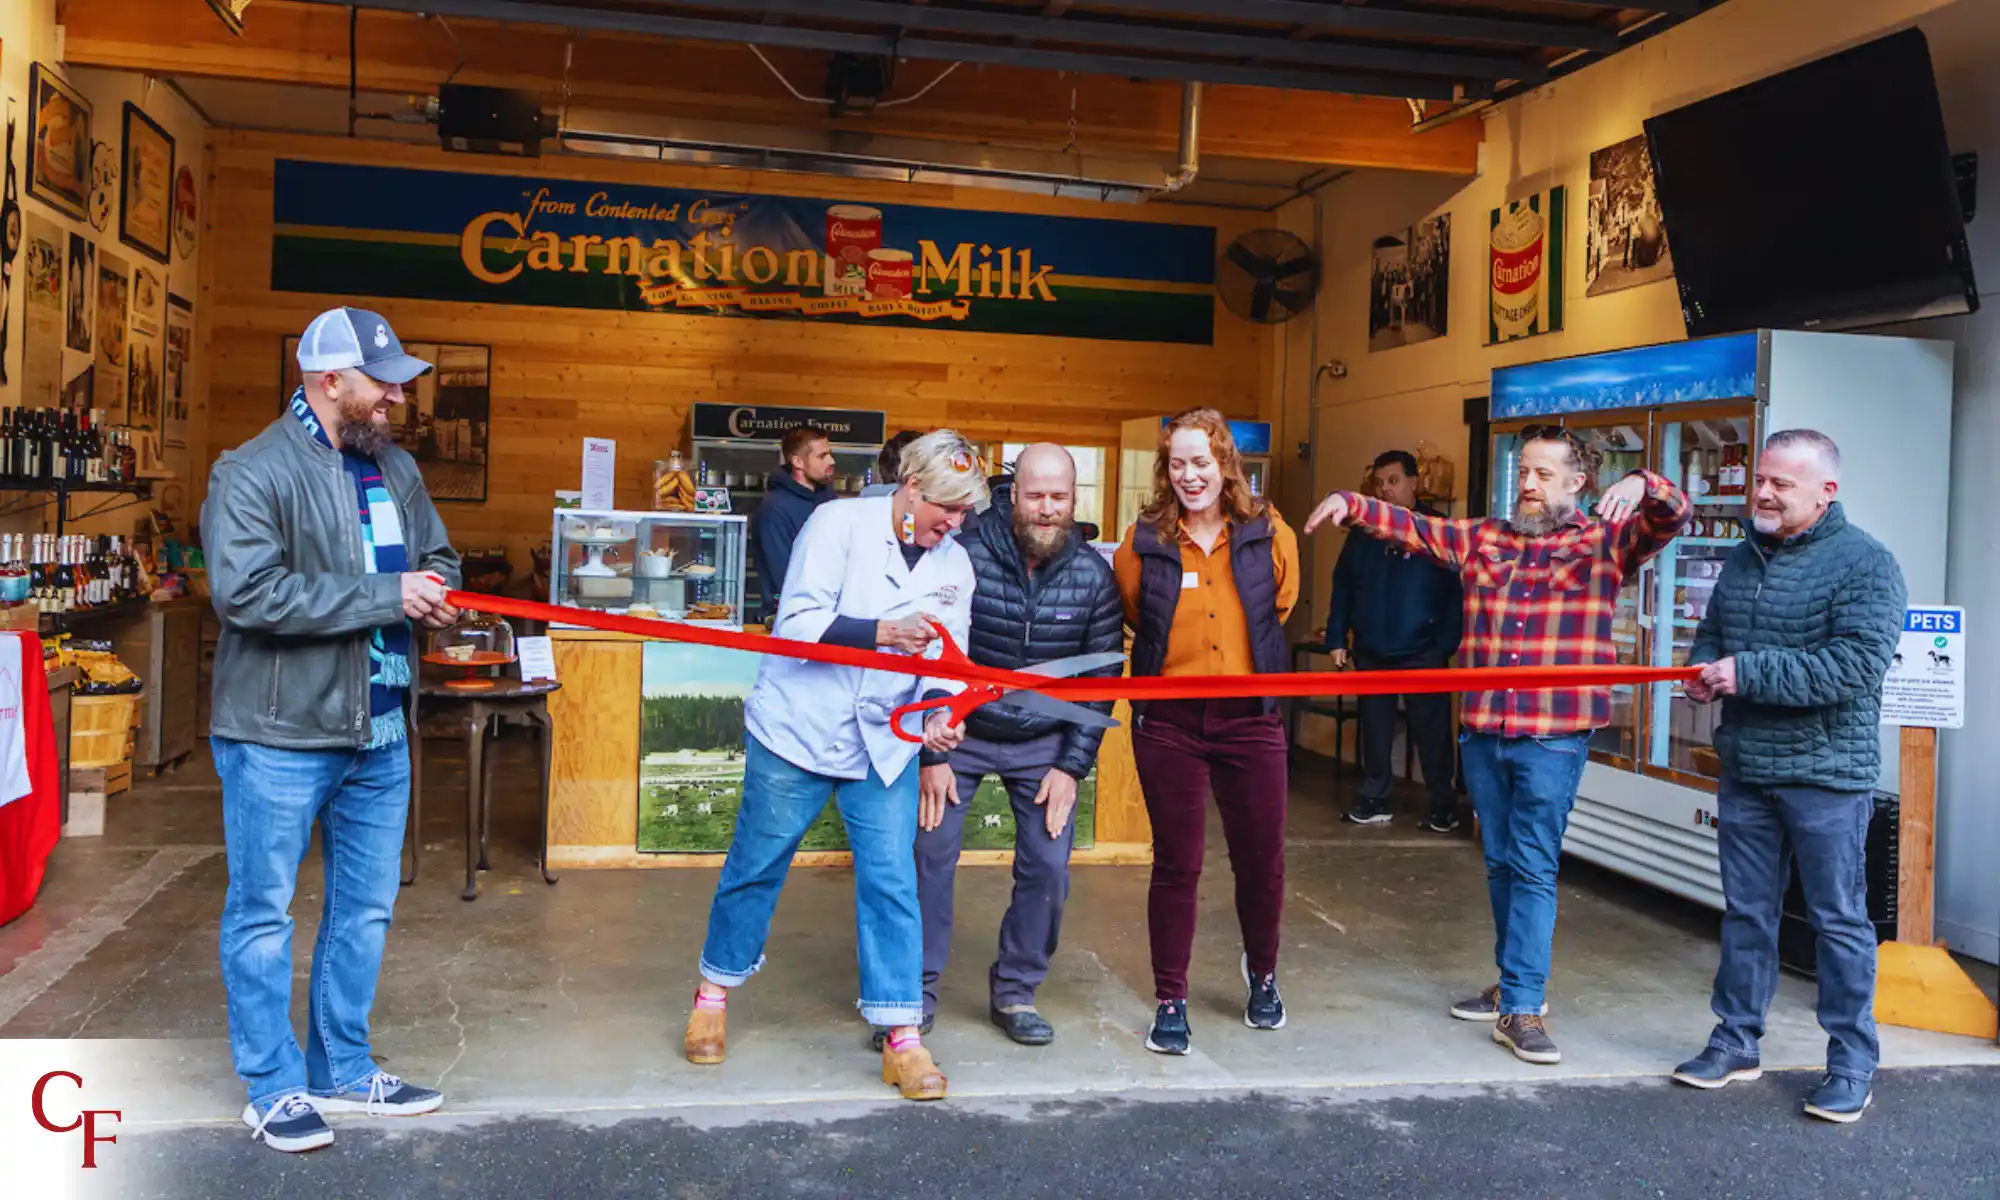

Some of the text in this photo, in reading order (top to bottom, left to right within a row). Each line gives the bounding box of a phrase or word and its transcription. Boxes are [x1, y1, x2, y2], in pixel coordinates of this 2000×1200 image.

[585, 191, 680, 222] Contented
[461, 211, 1058, 301] Carnation Milk
[728, 407, 802, 438] Carnation
[1910, 613, 1955, 630] PETS
